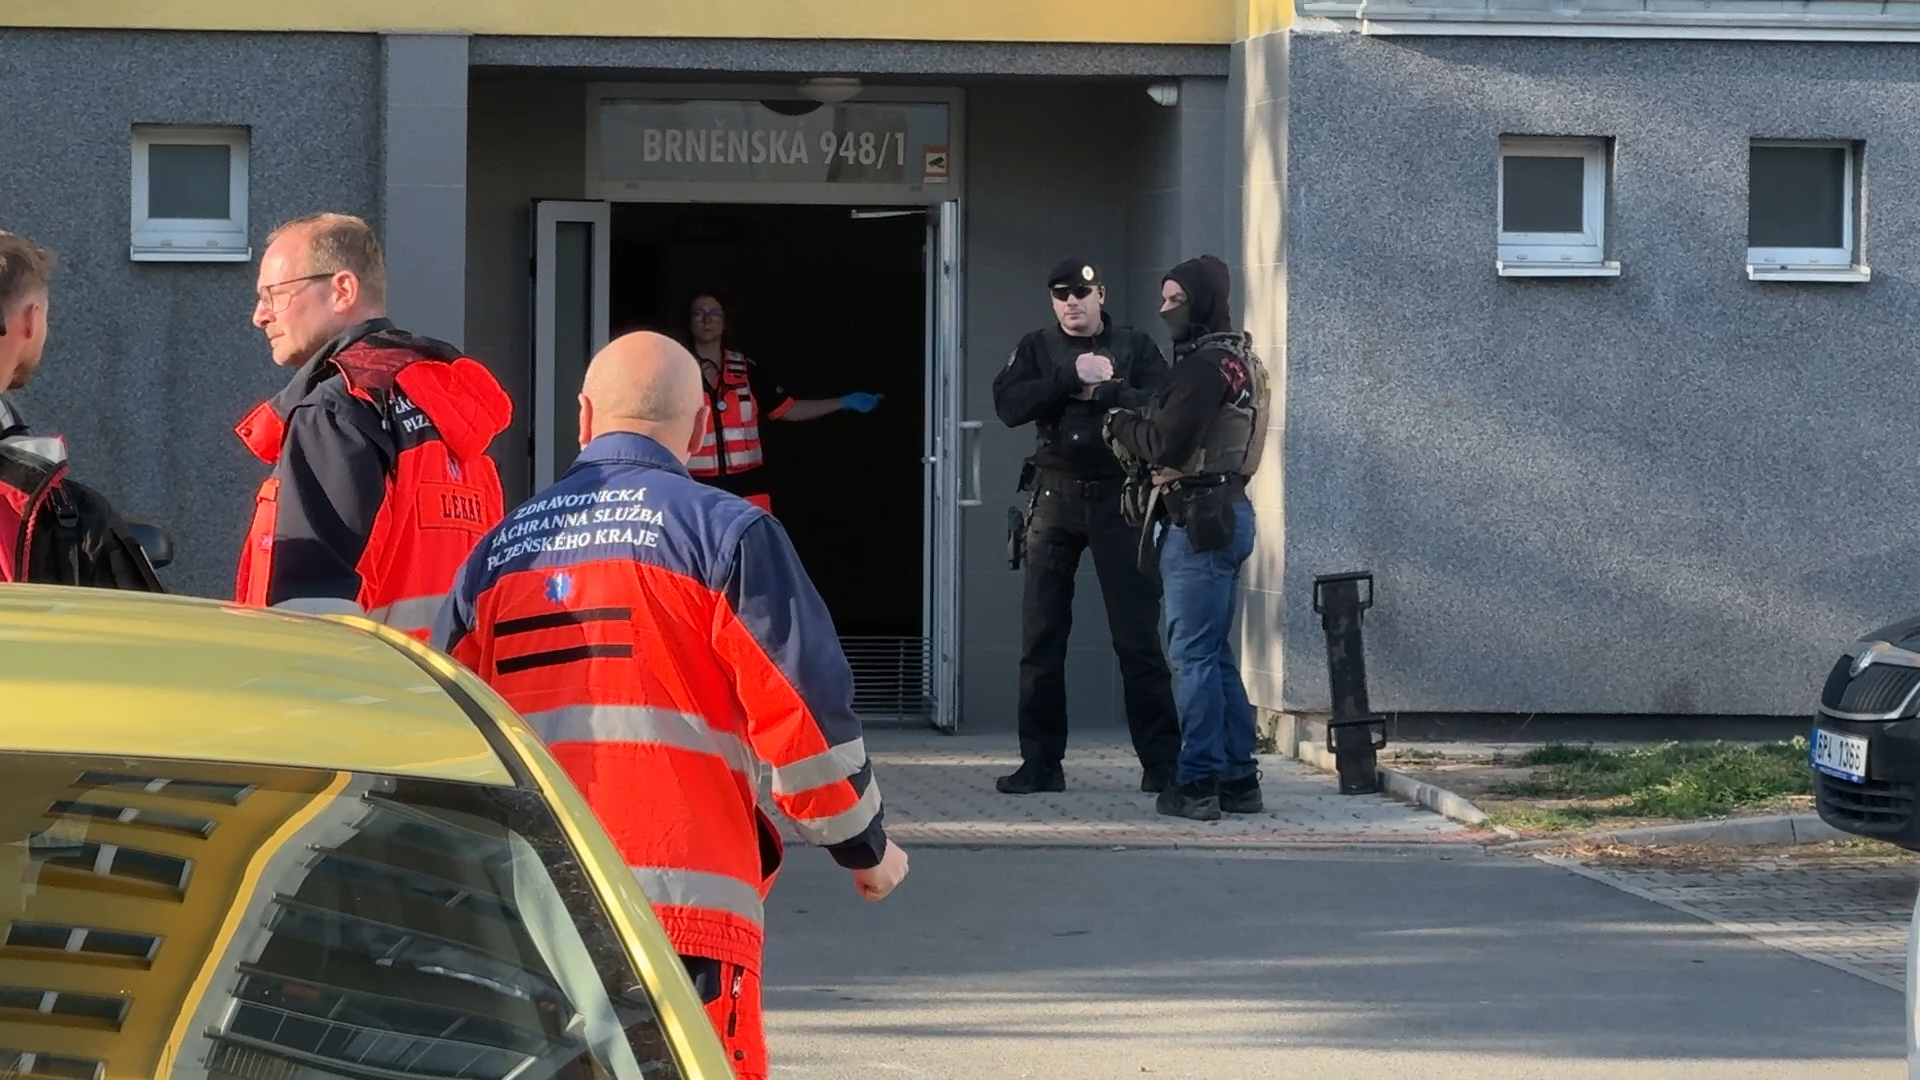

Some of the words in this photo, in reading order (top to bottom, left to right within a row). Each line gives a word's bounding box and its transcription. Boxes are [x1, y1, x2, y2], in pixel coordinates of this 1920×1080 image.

[643, 119, 809, 164] BRNĚNSKÁ
[820, 131, 905, 170] 948/1
[513, 487, 647, 520] ZDRAVOTNICKÁ
[593, 504, 664, 527] SLUŽBA
[487, 531, 591, 571] PLZEŇSKÉHO
[594, 528, 659, 547] KRAJE
